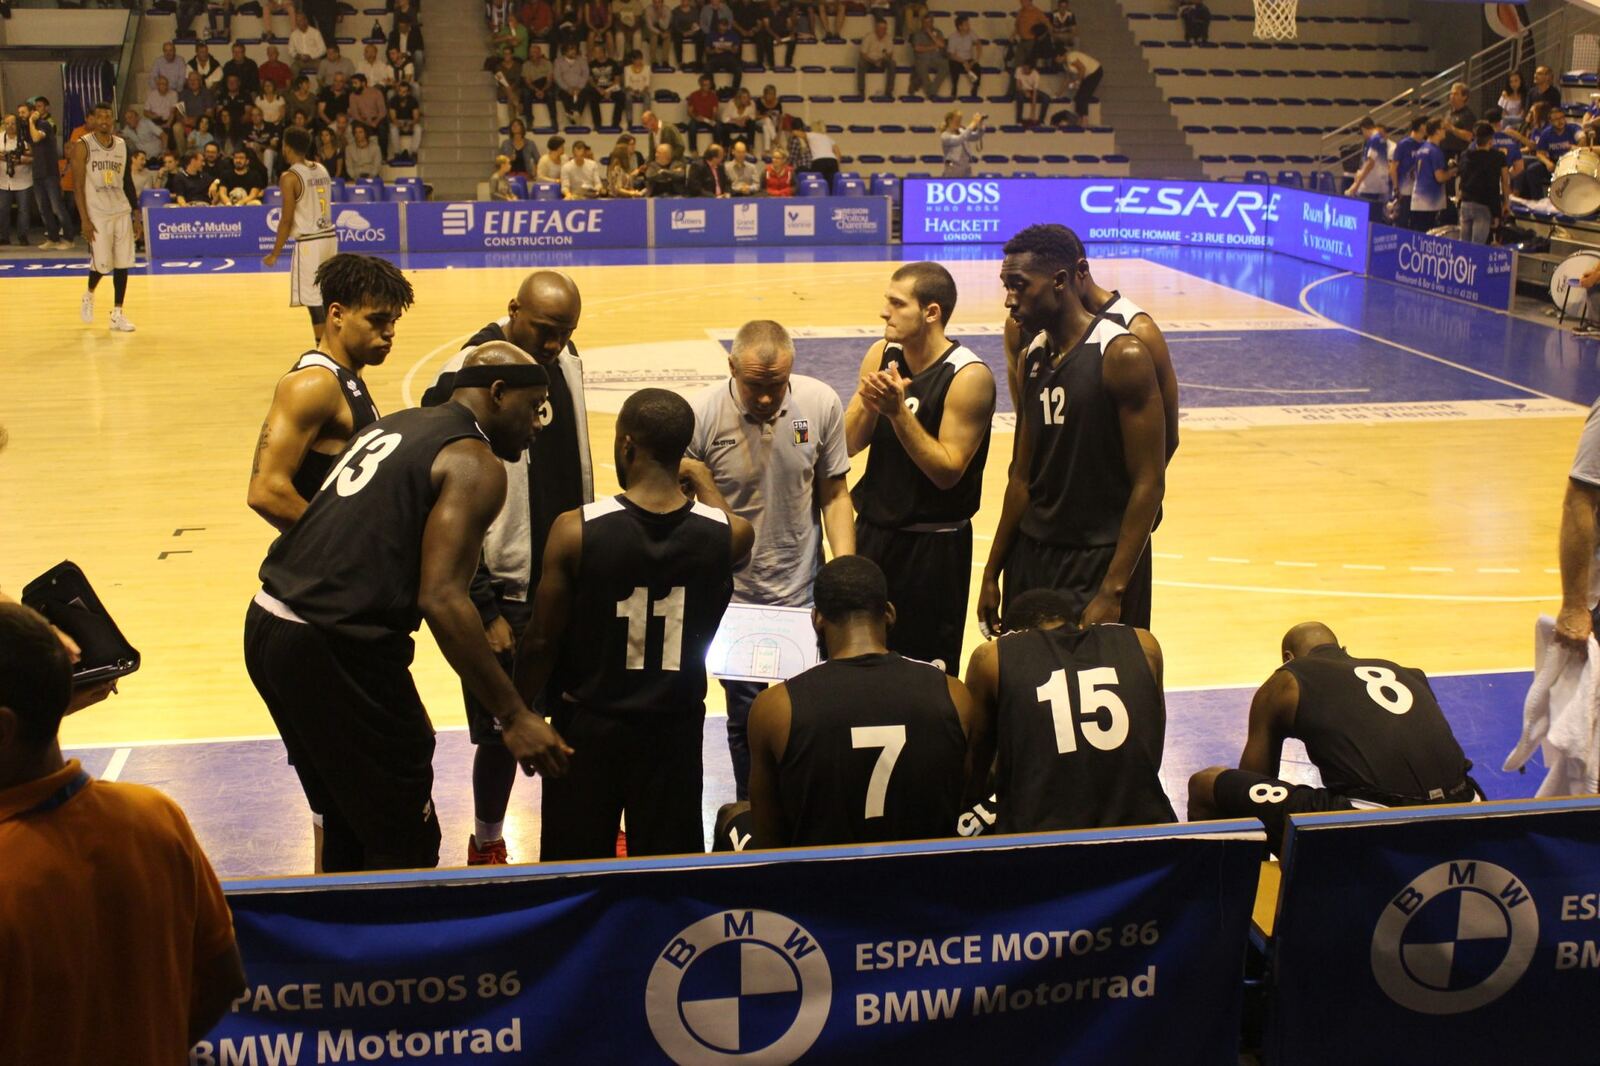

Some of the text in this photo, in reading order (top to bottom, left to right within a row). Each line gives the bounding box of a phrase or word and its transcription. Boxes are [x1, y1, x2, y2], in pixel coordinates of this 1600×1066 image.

[926, 182, 1000, 205] BOSS
[1080, 185, 1281, 235] CESARE
[158, 221, 241, 233] Crédit Mutuel
[484, 209, 603, 235] EIFFAGE
[484, 236, 573, 247] CONSTRUCTION
[925, 218, 1000, 232] HACKETT
[943, 233, 982, 241] LONDON
[1089, 228, 1140, 240] BOUTIQUE
[1142, 231, 1181, 241] HOMME
[1191, 232, 1204, 242] 23
[1205, 233, 1225, 244] RUE
[1040, 386, 1066, 425] 12
[320, 428, 402, 498] 13
[616, 586, 686, 671] 11
[1036, 667, 1130, 754] 15
[1354, 666, 1413, 715] 8
[850, 724, 907, 820] 7
[1249, 783, 1288, 804] 8
[1391, 862, 1530, 916] BMW
[662, 911, 817, 970] BMW
[855, 919, 1160, 971] ESPACE MOTOS 86
[334, 973, 467, 1009] MOTOS
[477, 970, 521, 998] 86
[855, 964, 1156, 1026] BMW Motorrad
[317, 1017, 522, 1064] Motorrad
